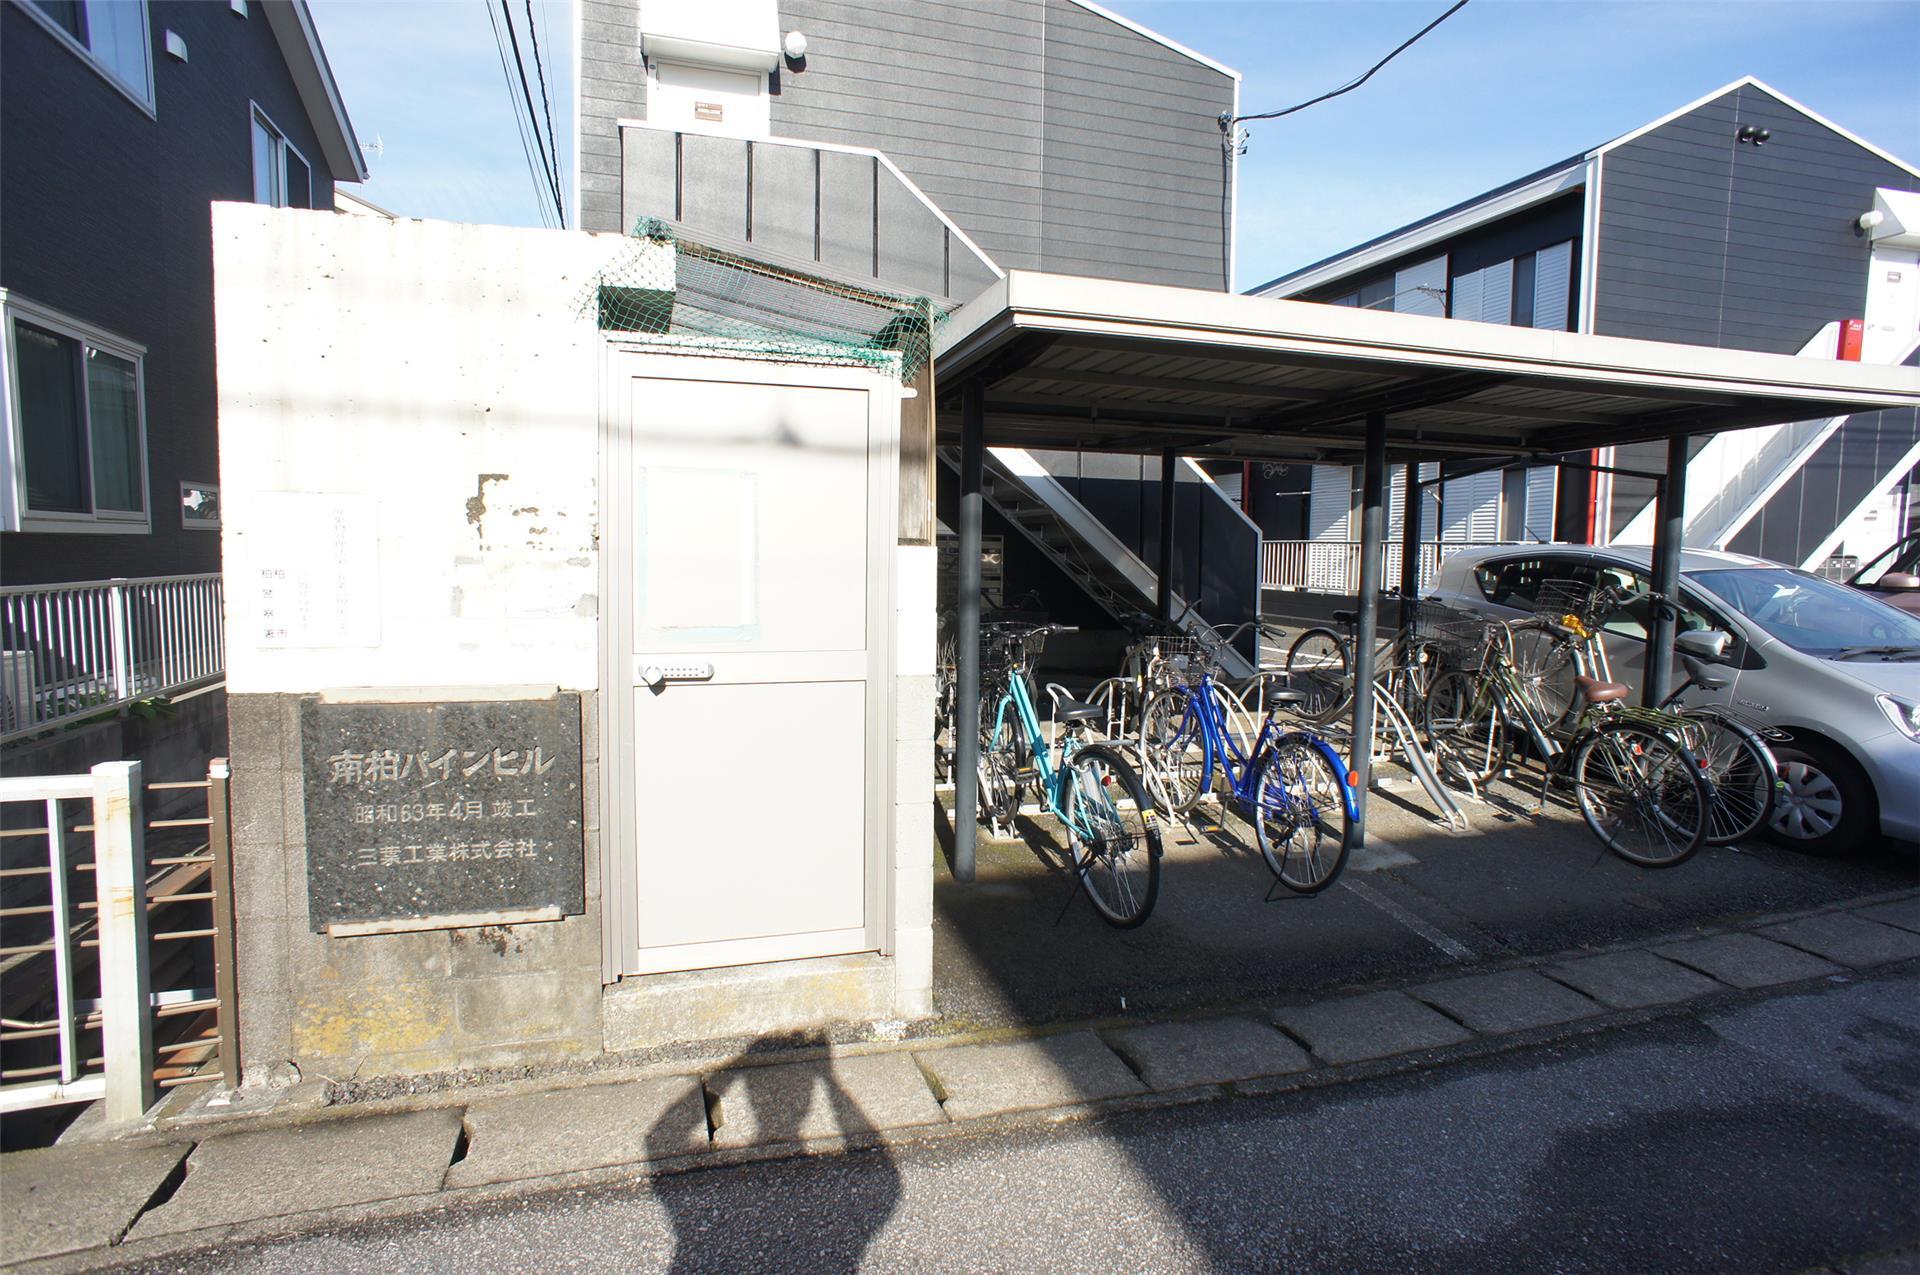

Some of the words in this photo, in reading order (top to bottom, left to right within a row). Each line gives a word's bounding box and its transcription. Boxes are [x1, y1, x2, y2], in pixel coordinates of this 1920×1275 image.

[327, 745, 557, 784] 南柏パインヒル
[356, 838, 538, 867] 三葉工業株式会社
